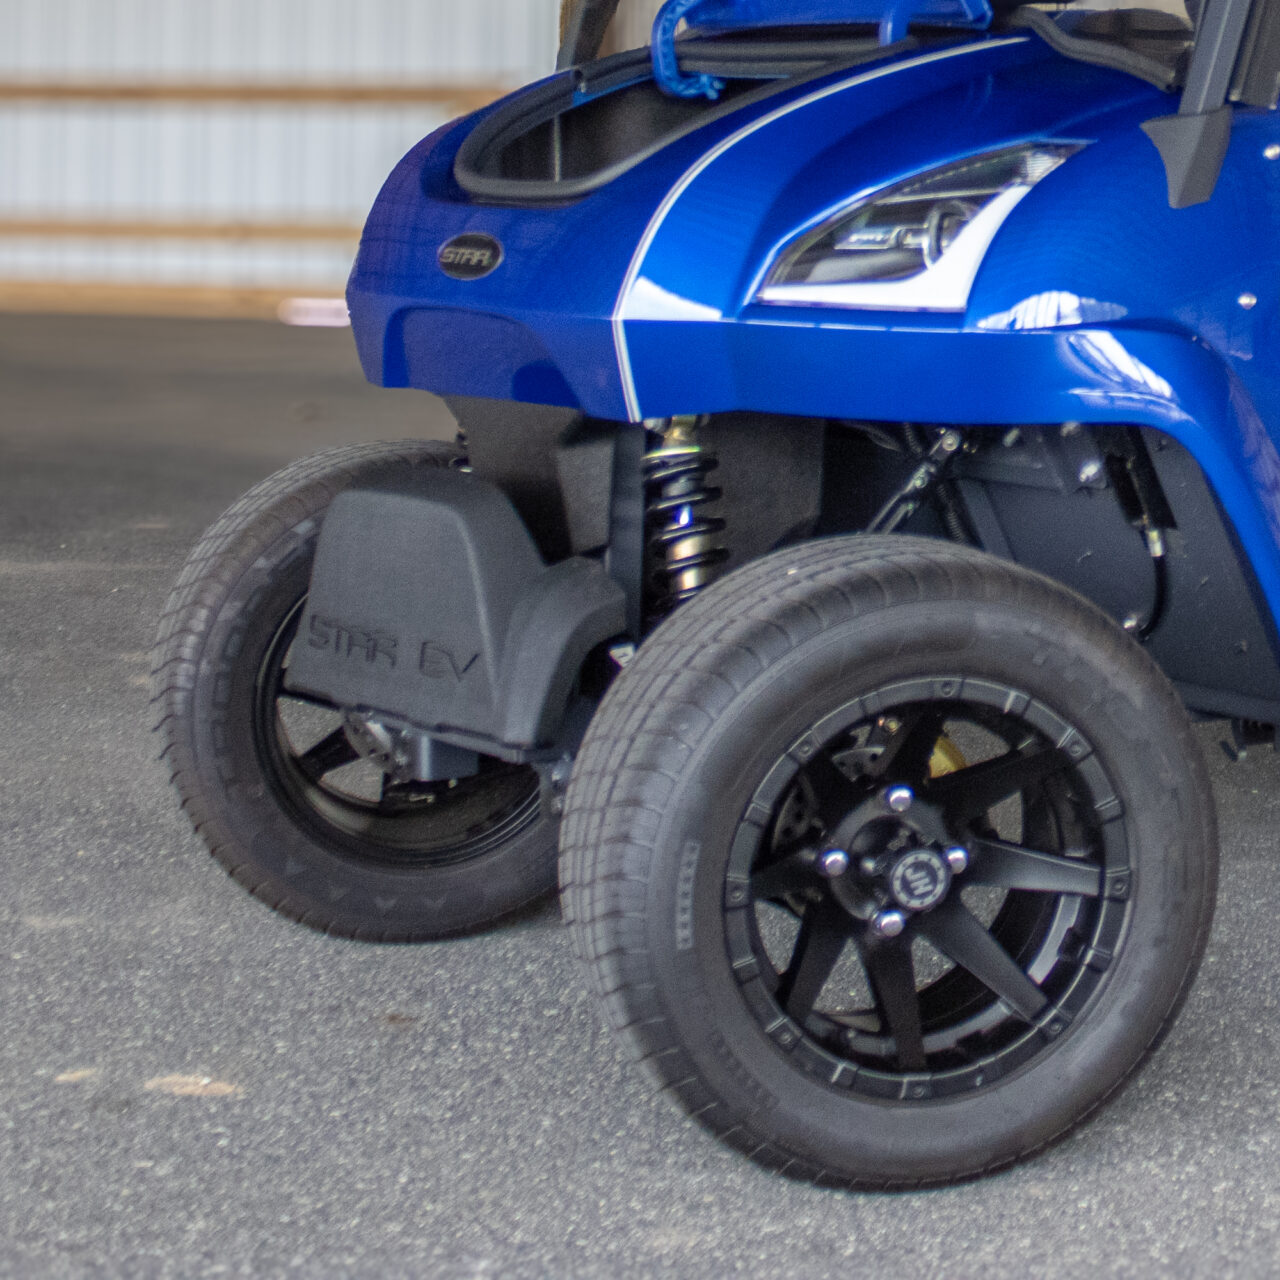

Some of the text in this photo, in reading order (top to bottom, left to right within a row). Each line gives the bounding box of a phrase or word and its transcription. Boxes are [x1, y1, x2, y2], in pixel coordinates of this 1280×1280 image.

[440, 247, 491, 267] STAR
[307, 615, 480, 683] STAR EV
